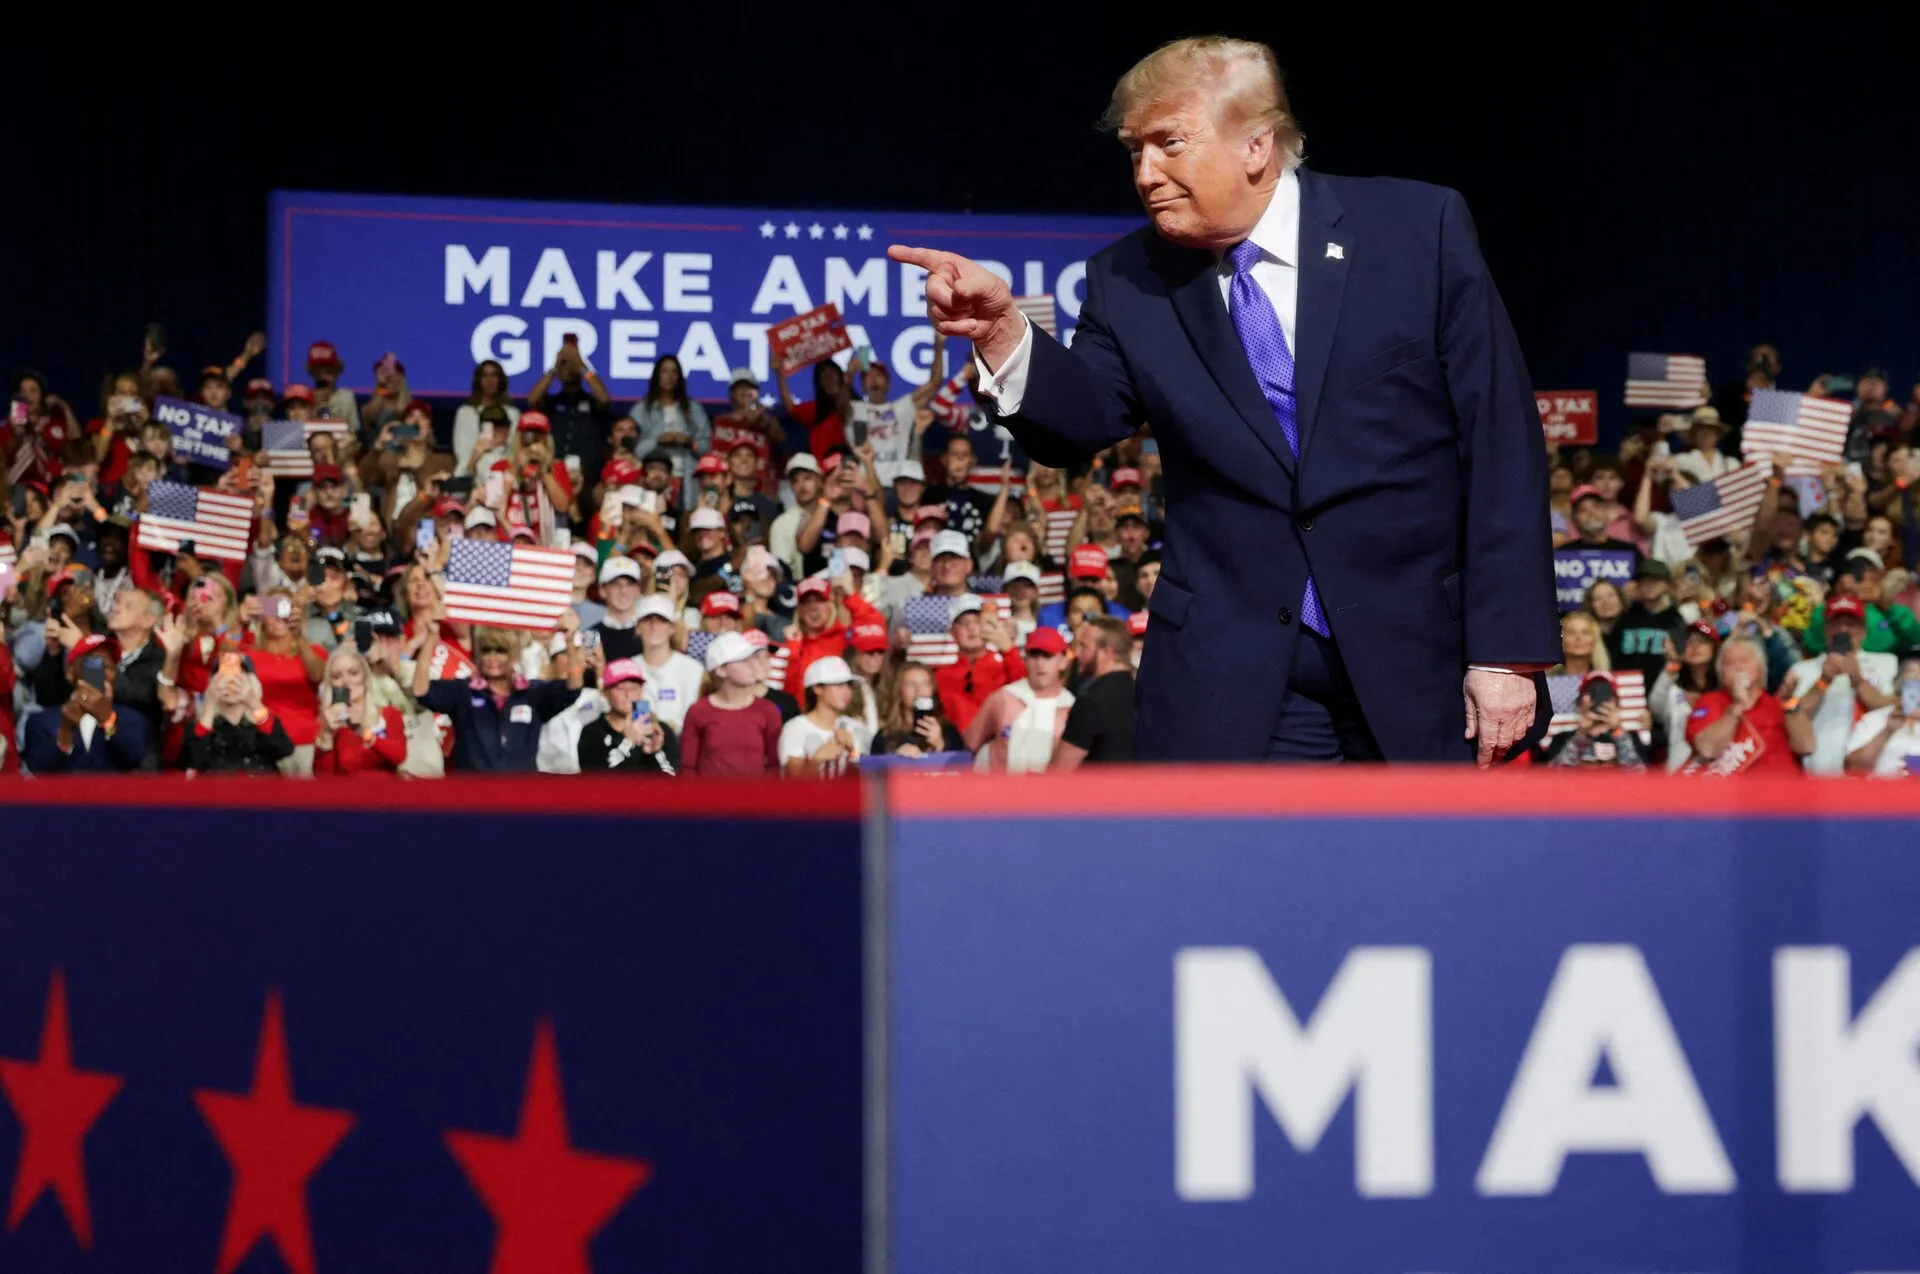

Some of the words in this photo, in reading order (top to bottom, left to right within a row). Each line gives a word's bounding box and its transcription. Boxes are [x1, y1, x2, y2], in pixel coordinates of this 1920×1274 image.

[445, 243, 713, 313] MAKE
[470, 314, 772, 383] GREAT
[158, 404, 191, 426] NO
[195, 412, 235, 437] TAX
[1554, 397, 1592, 413] TAX
[1554, 559, 1585, 578] NO
[1587, 560, 1631, 579] TAX
[1174, 943, 1920, 1201] MAK
